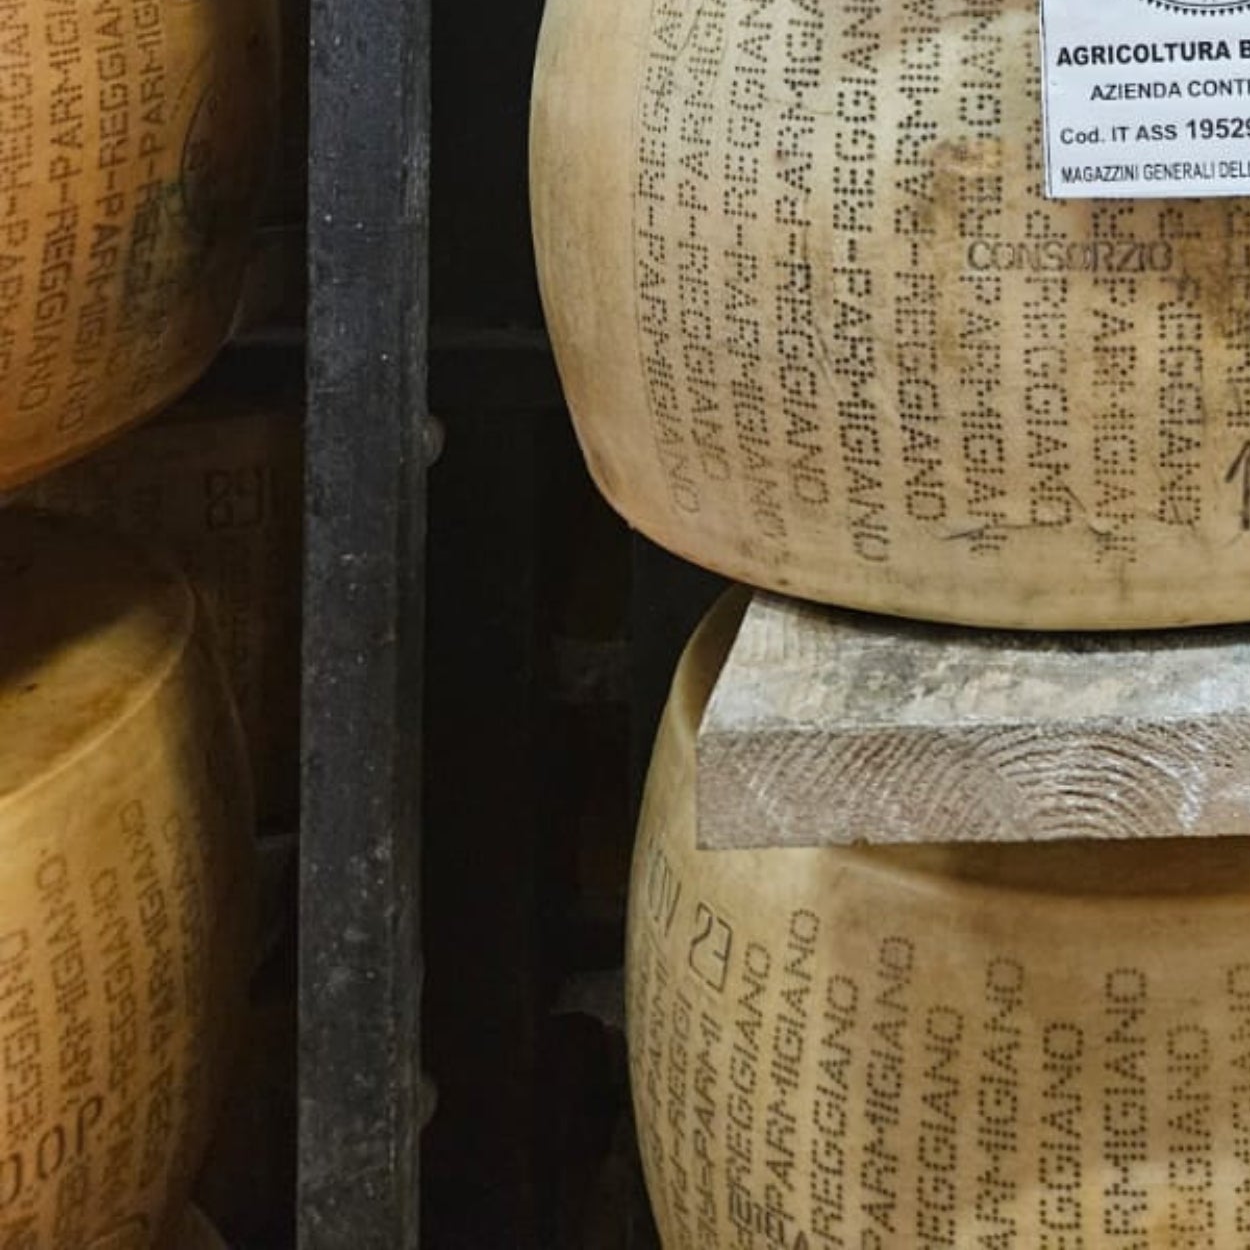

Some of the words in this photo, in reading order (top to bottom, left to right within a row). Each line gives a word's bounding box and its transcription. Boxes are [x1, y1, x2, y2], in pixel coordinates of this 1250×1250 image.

[1056, 39, 1232, 67] AGRICOLTURA
[1060, 126, 1104, 144] Cod.
[1111, 126, 1130, 143] IT
[1135, 124, 1178, 142] ASS
[1061, 164, 1139, 184] MAGAZZINI
[1143, 161, 1216, 181] GENERALI
[1090, 81, 1182, 101] AZIENDA
[18, 205, 79, 412] REGGIANO
[967, 240, 1175, 273] CONSORZIO
[774, 260, 830, 505] REGGIANO
[832, 265, 891, 562] PARMIGIANO
[894, 271, 947, 520] REGGIANO
[1024, 277, 1071, 526] REGGIANO
[1157, 276, 1203, 526] REGGIANO
[689, 901, 734, 994] 23
[723, 939, 772, 1195] REGGIANO
[763, 907, 822, 1222] PARMIGIANO
[810, 973, 861, 1246] REGGIANO
[916, 1003, 965, 1250] EGGIANO
[1103, 966, 1149, 1250] RMIGIANO
